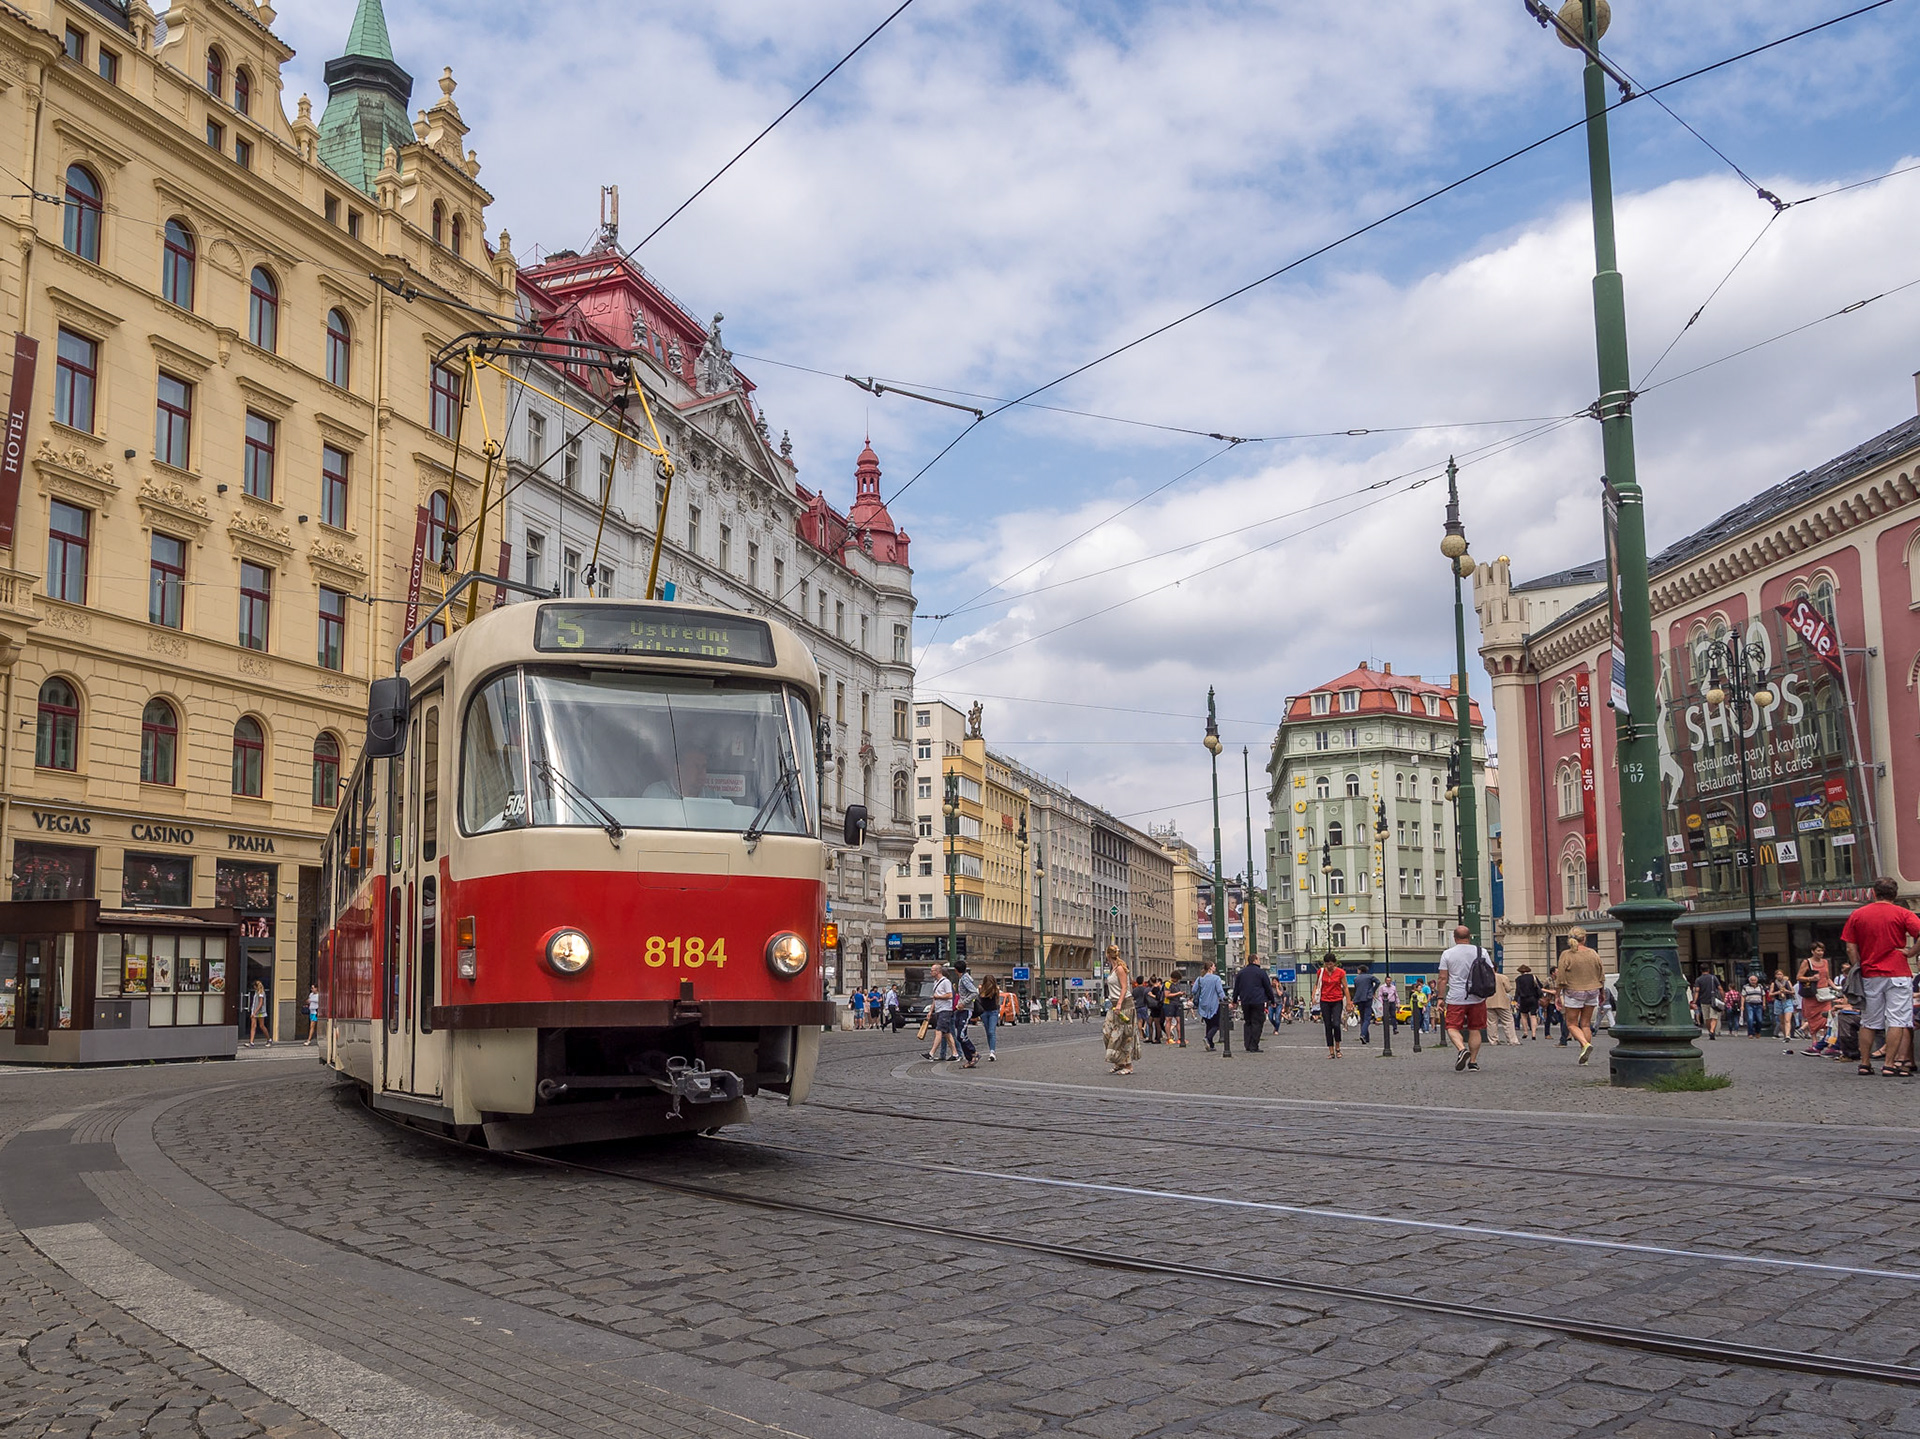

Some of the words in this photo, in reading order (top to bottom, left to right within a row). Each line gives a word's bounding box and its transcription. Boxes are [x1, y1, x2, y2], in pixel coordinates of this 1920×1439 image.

[4, 410, 25, 473] HOTEL
[406, 590, 418, 632] KINGS
[412, 545, 424, 588] COURT
[557, 611, 585, 648] 5
[1792, 602, 1831, 656] Sale
[1578, 685, 1589, 707] Sale
[1685, 673, 1804, 752] SHOPS
[1580, 727, 1591, 749] Sale
[1768, 744, 1775, 755] a
[1776, 732, 1818, 753] kavárny
[1582, 768, 1594, 791] Sale
[1623, 762, 1643, 773] 052
[1630, 773, 1645, 783] 07
[1696, 770, 1749, 793] restaurant,
[1750, 765, 1771, 781] bars
[1774, 760, 1784, 775] &
[1785, 754, 1813, 772] cafés
[504, 794, 526, 816] 509
[1371, 768, 1381, 814] CITY
[1706, 810, 1728, 819] RESERVED
[32, 811, 91, 835] VEGAS
[131, 823, 194, 845] CASINO
[228, 834, 275, 854] PRAHA
[1294, 775, 1309, 890] HOTEL
[1373, 821, 1383, 889] CNTRE
[1780, 887, 1877, 904] PALLADIUM
[644, 936, 728, 968] 8184
